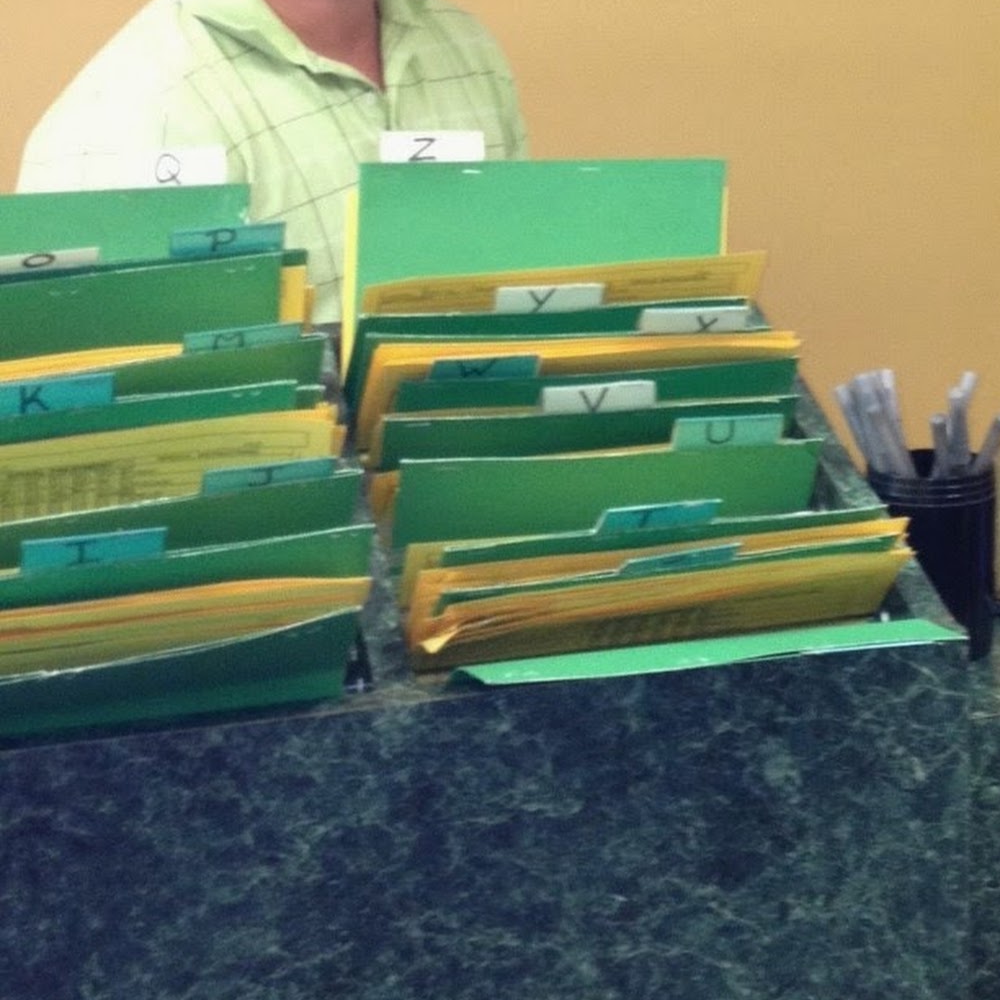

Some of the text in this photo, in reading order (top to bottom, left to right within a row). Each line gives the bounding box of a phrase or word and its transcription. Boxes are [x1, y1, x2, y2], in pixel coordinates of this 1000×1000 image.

[408, 137, 437, 161] Z
[155, 152, 181, 185] Q
[206, 227, 236, 252] P
[528, 288, 557, 312] Y
[213, 330, 245, 350] M
[457, 358, 497, 378] W
[20, 385, 49, 414] K
[578, 386, 609, 413] V
[705, 421, 735, 446] U
